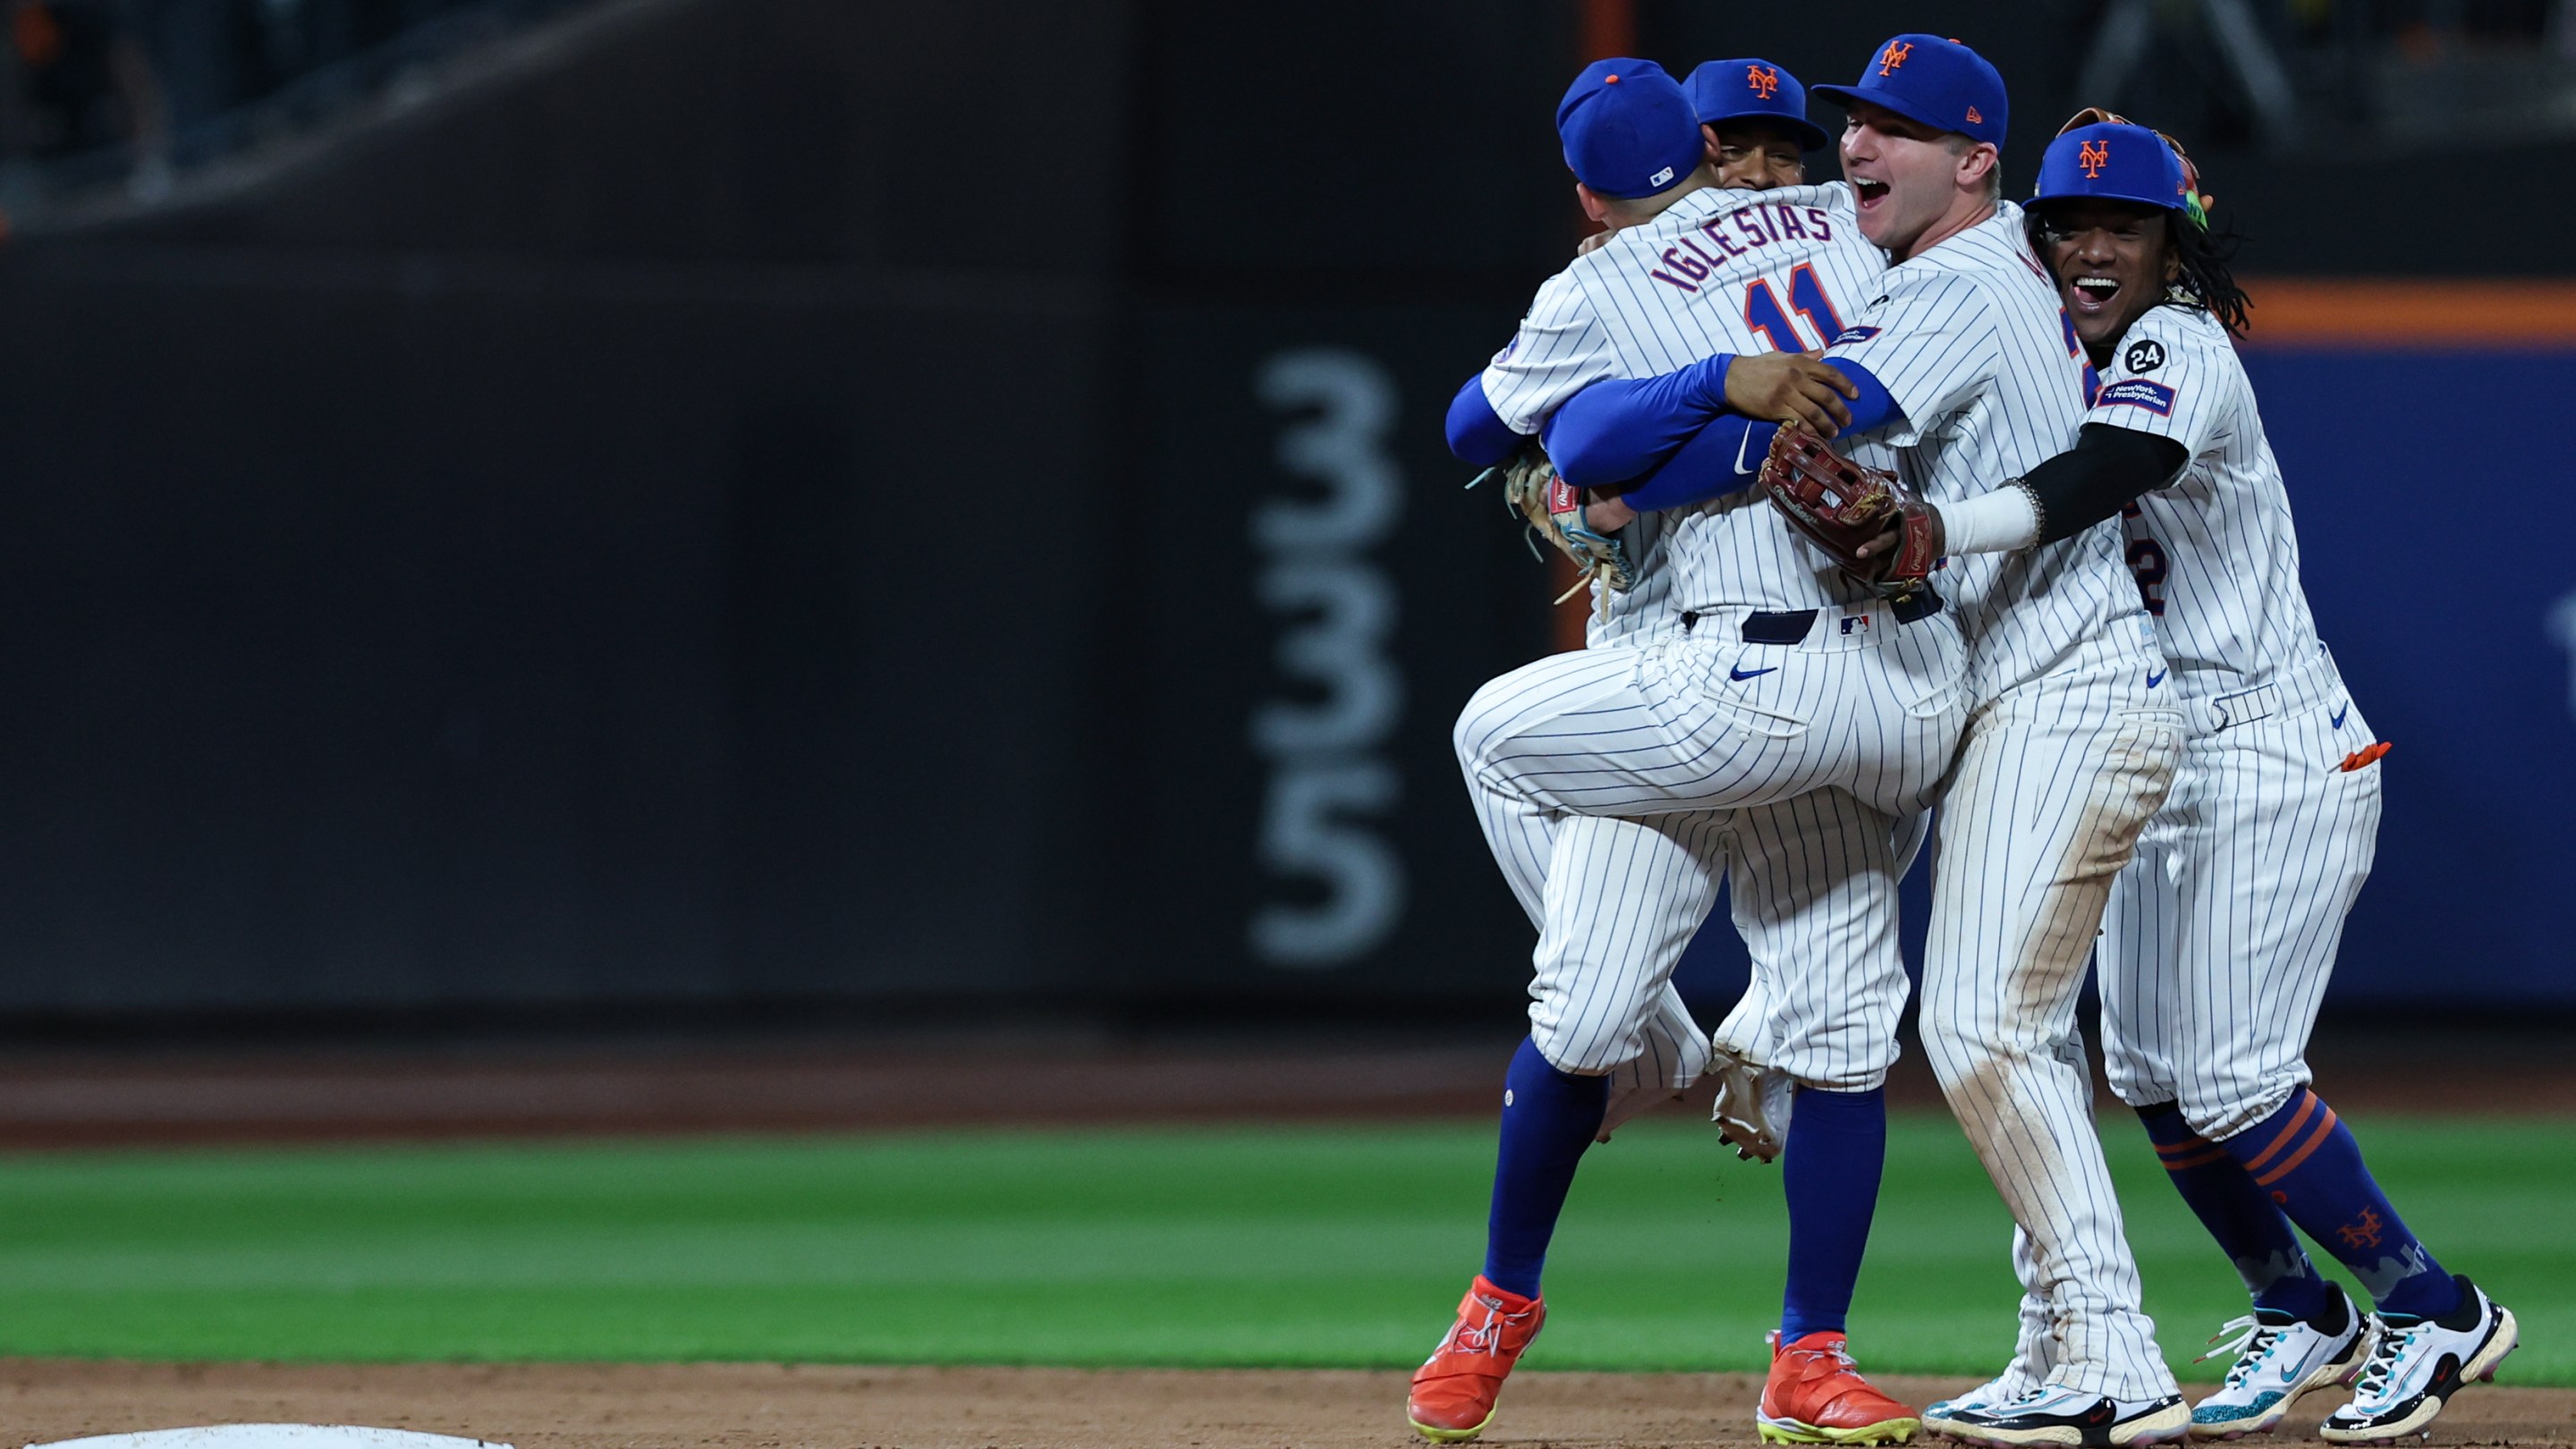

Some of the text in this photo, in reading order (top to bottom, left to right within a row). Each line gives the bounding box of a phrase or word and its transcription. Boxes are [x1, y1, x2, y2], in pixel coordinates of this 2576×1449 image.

[1650, 200, 1833, 293] IGLESIAS
[1743, 261, 1847, 352] 11
[2130, 343, 2160, 371] 24
[2113, 391, 2167, 408] Presbyterian
